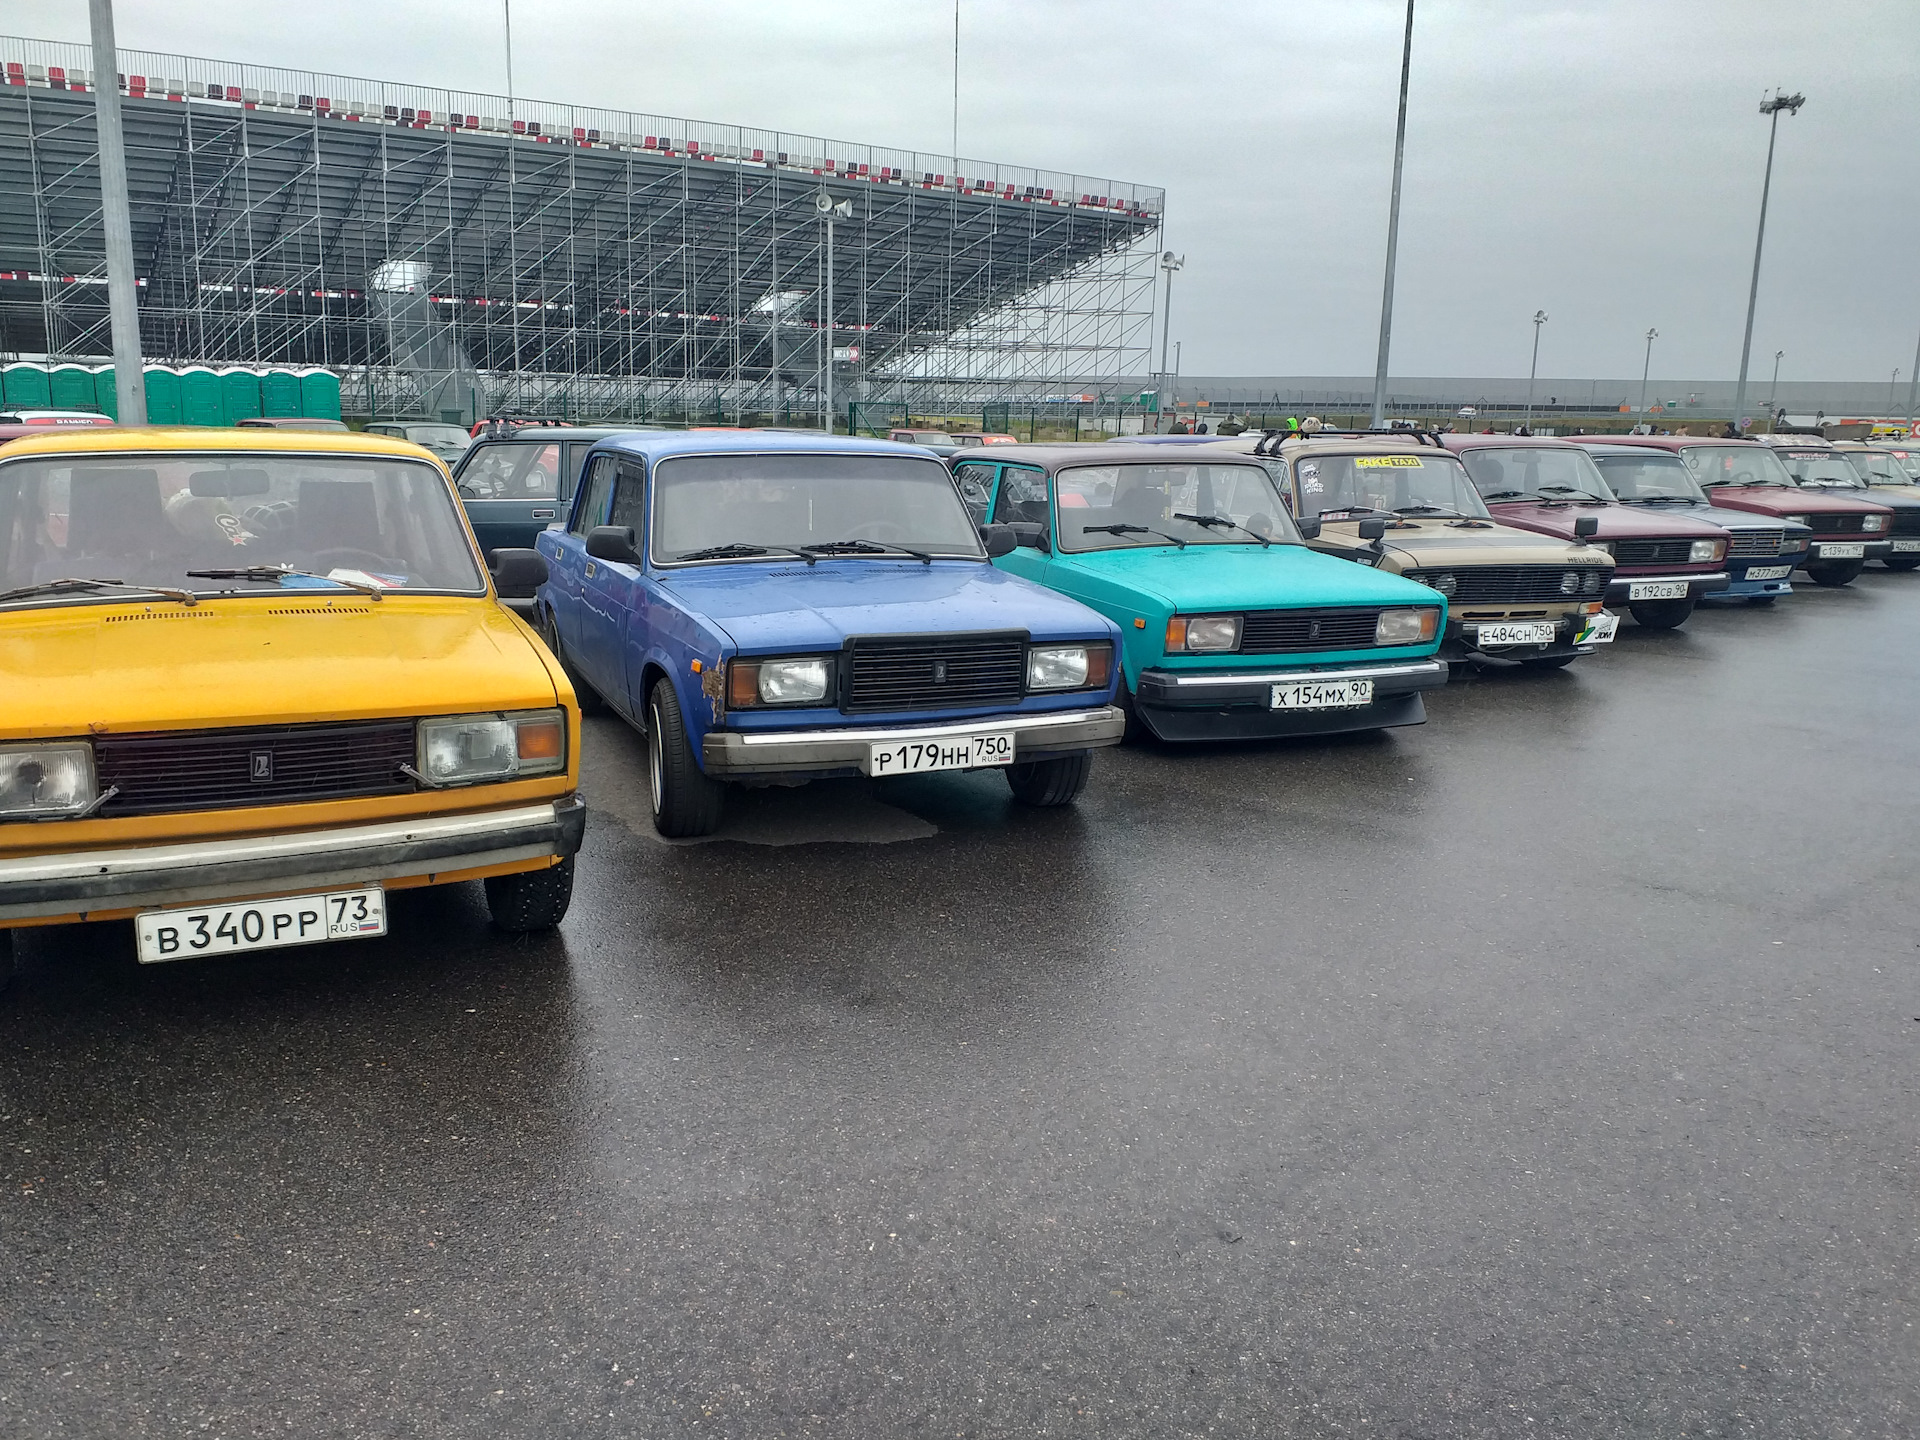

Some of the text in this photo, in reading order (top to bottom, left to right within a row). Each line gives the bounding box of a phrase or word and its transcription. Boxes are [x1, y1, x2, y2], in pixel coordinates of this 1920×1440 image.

[1356, 458, 1418, 467] FAKE TAXI
[1566, 556, 1604, 564] HELLRIDE
[1533, 625, 1551, 637] 750
[1594, 631, 1613, 640] JDM
[1351, 682, 1368, 697] 90
[974, 736, 1008, 756] 750
[981, 754, 998, 763] RUS
[330, 895, 369, 924] 73
[329, 921, 359, 934] RUS
